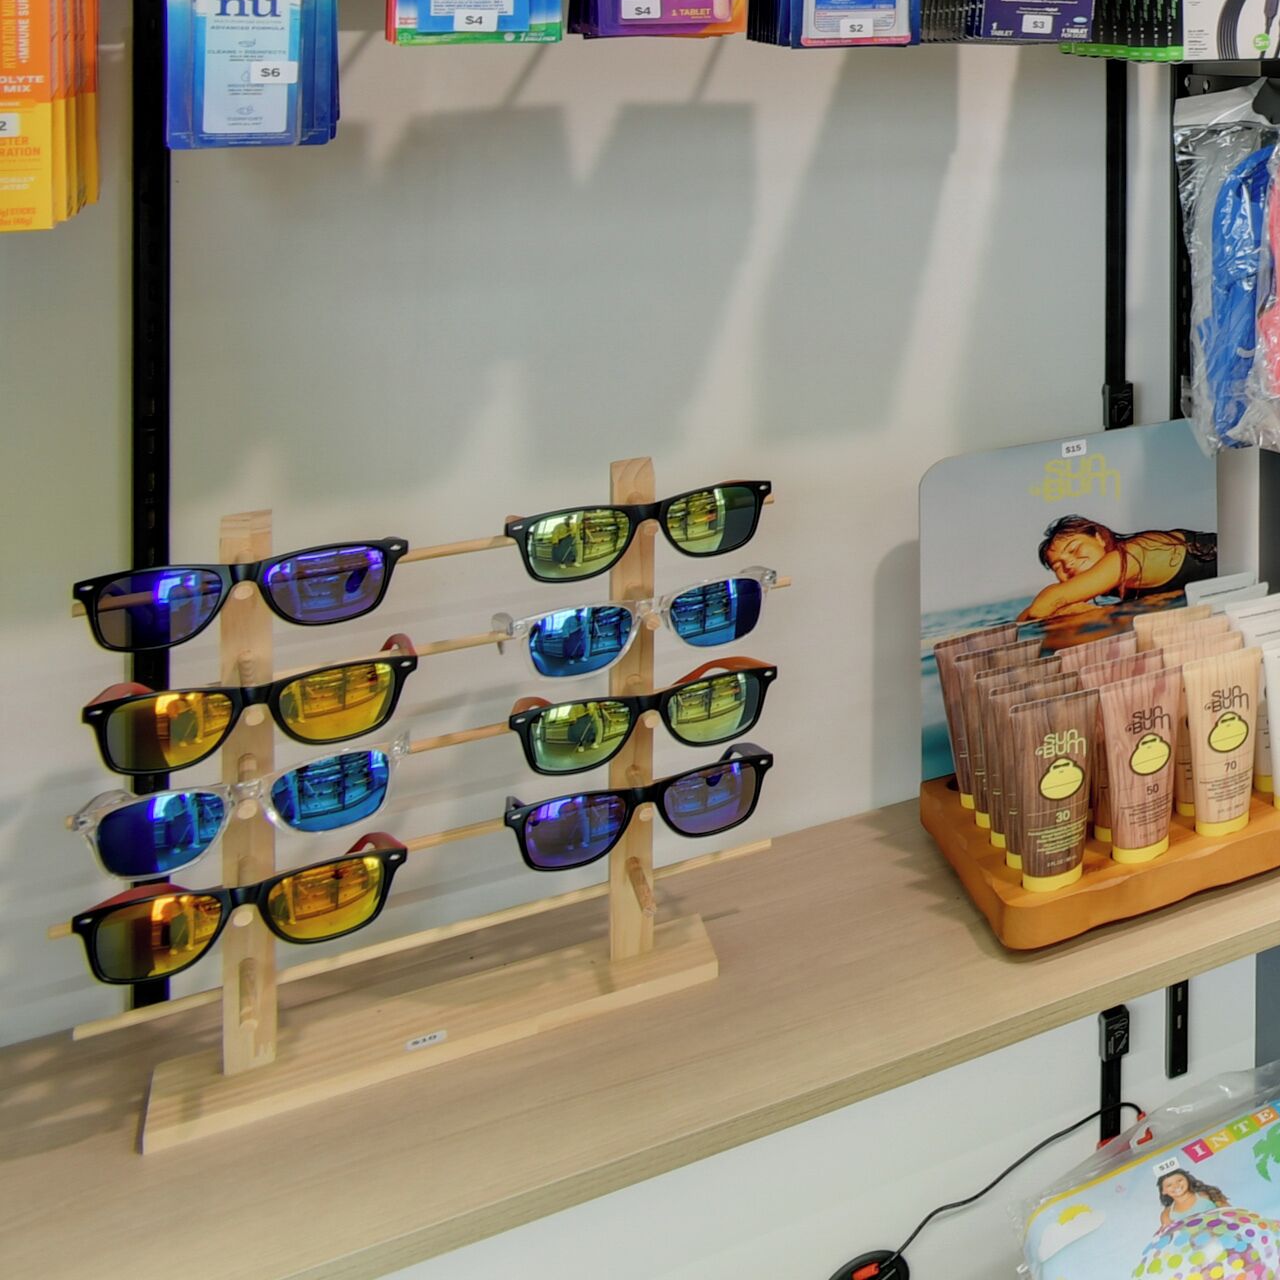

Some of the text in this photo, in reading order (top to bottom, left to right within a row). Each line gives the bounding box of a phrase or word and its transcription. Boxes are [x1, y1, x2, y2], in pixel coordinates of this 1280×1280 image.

[635, 7, 651, 16] $4
[680, 9, 711, 17] TABLET
[465, 16, 483, 26] $4
[1032, 21, 1045, 29] $3
[849, 24, 863, 33] $2
[260, 67, 281, 78] $6
[4, 84, 31, 93] MIX
[1065, 444, 1082, 454] $15
[1224, 760, 1237, 773] 70
[1147, 784, 1160, 795] 50
[1056, 810, 1071, 823] 30
[1159, 1160, 1176, 1172] $10
